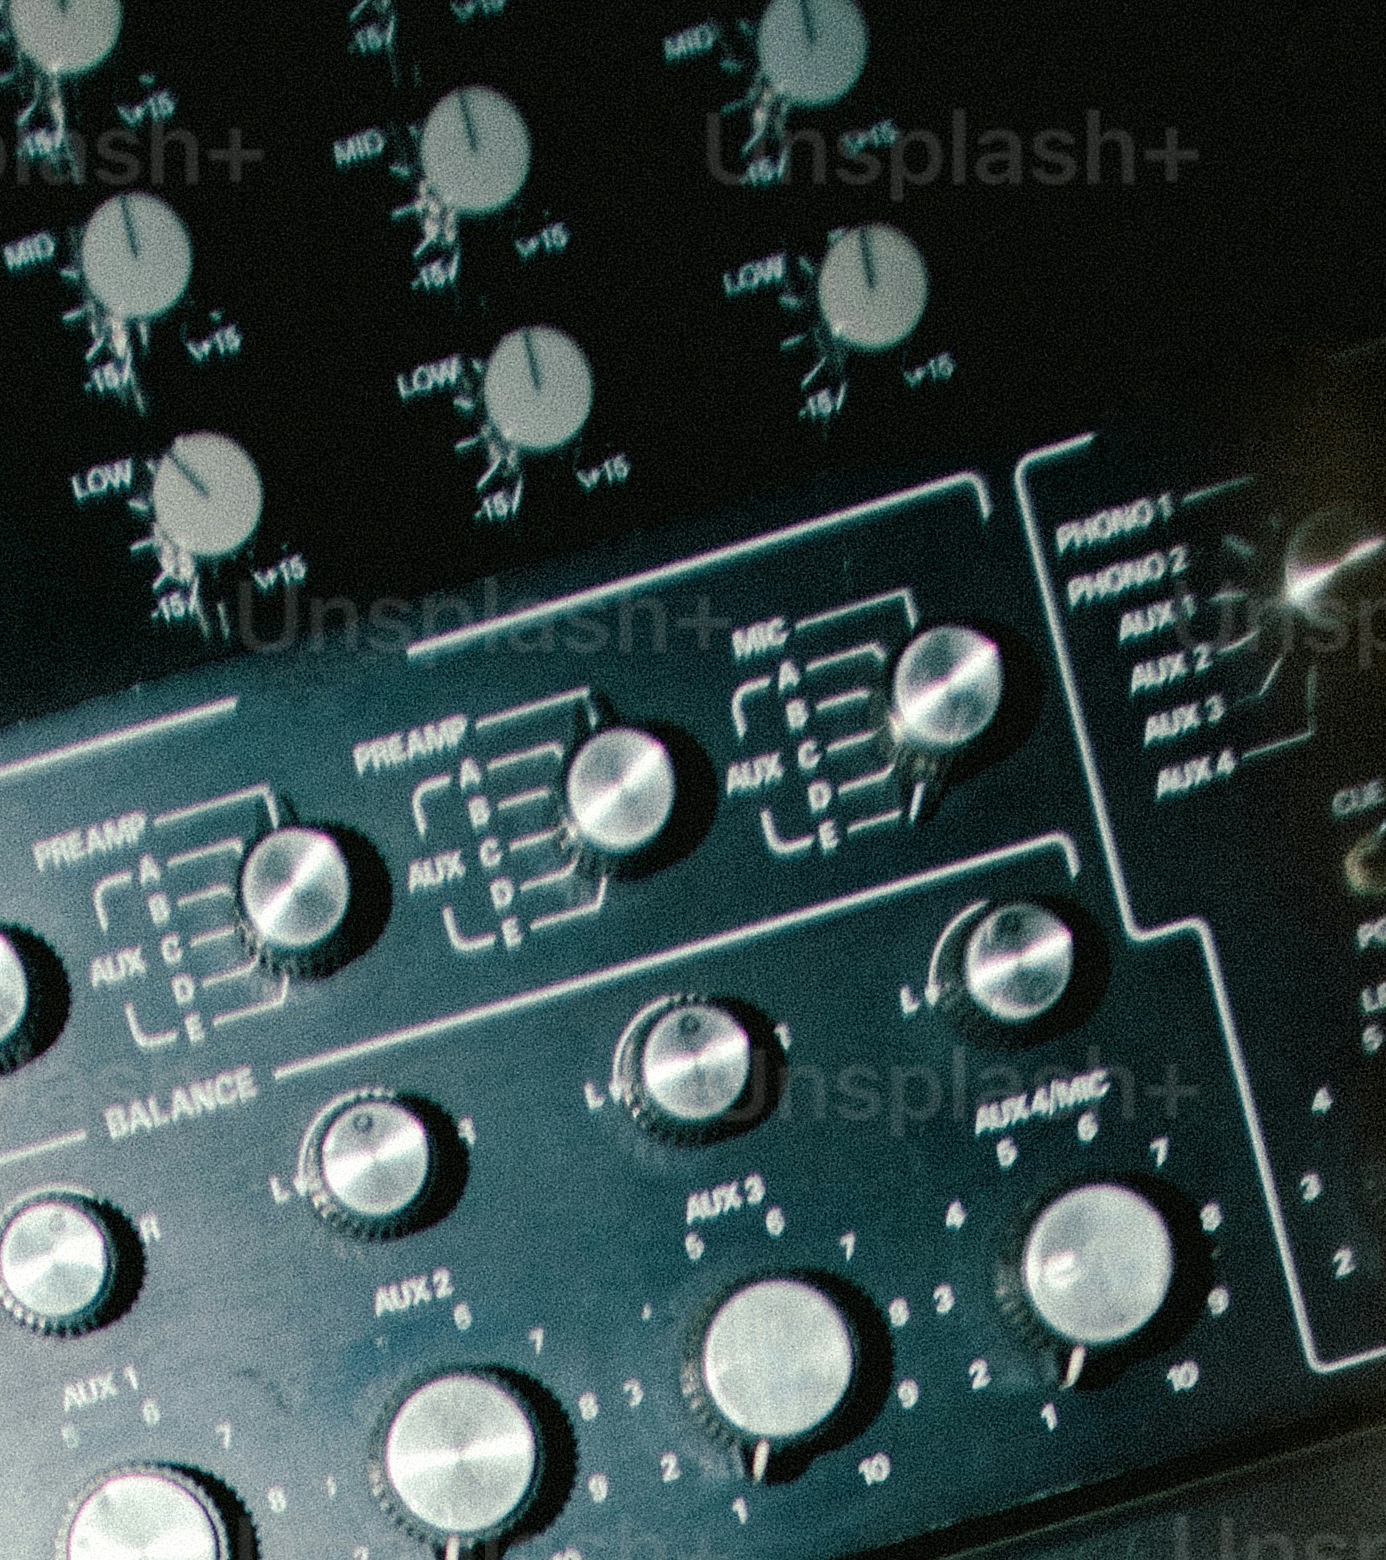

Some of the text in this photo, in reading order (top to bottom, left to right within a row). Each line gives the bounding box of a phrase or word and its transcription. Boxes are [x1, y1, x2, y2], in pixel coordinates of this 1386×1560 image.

[662, 23, 719, 62] MID
[333, 128, 387, 169] MID
[2, 232, 57, 272] MID
[724, 253, 786, 296] LOW
[397, 355, 461, 401] LOW
[71, 457, 132, 502] LOW
[1055, 493, 1173, 556] PHONO 1
[1067, 544, 1188, 610] PHONO 2
[733, 620, 790, 660] MIC
[1119, 601, 1173, 646] AUX
[778, 661, 800, 689] A
[1131, 642, 1213, 697] AUX 2
[1144, 694, 1225, 749] AUX 3
[353, 715, 467, 776] PREAMP
[460, 758, 481, 788] A
[726, 756, 783, 796] AUX
[1156, 748, 1236, 802] AUX 4
[1332, 778, 1386, 820] CUE
[34, 814, 147, 872] PREAMP
[139, 856, 160, 883] A
[409, 850, 465, 891] AUX
[90, 949, 144, 988] AUX
[105, 1069, 257, 1141] BALANCE
[1312, 1084, 1333, 1113] 4
[1078, 1112, 1098, 1144] 6
[1149, 1136, 1169, 1167] 7
[686, 1173, 766, 1223] AUX 3
[1301, 1172, 1322, 1201] 3
[839, 1231, 857, 1262] 7
[1332, 1247, 1355, 1279] 2
[374, 1268, 454, 1318] AUX 2
[933, 1284, 954, 1316] 3
[529, 1327, 545, 1356] 7
[624, 1378, 644, 1406] 3
[969, 1358, 991, 1391] 2
[1166, 1359, 1199, 1393] 10
[64, 1378, 117, 1411] AUX
[216, 1422, 232, 1449] 7
[1040, 1403, 1058, 1432] 1
[660, 1450, 681, 1483] 2
[858, 1450, 891, 1486] 10
[732, 1496, 748, 1524] 1
